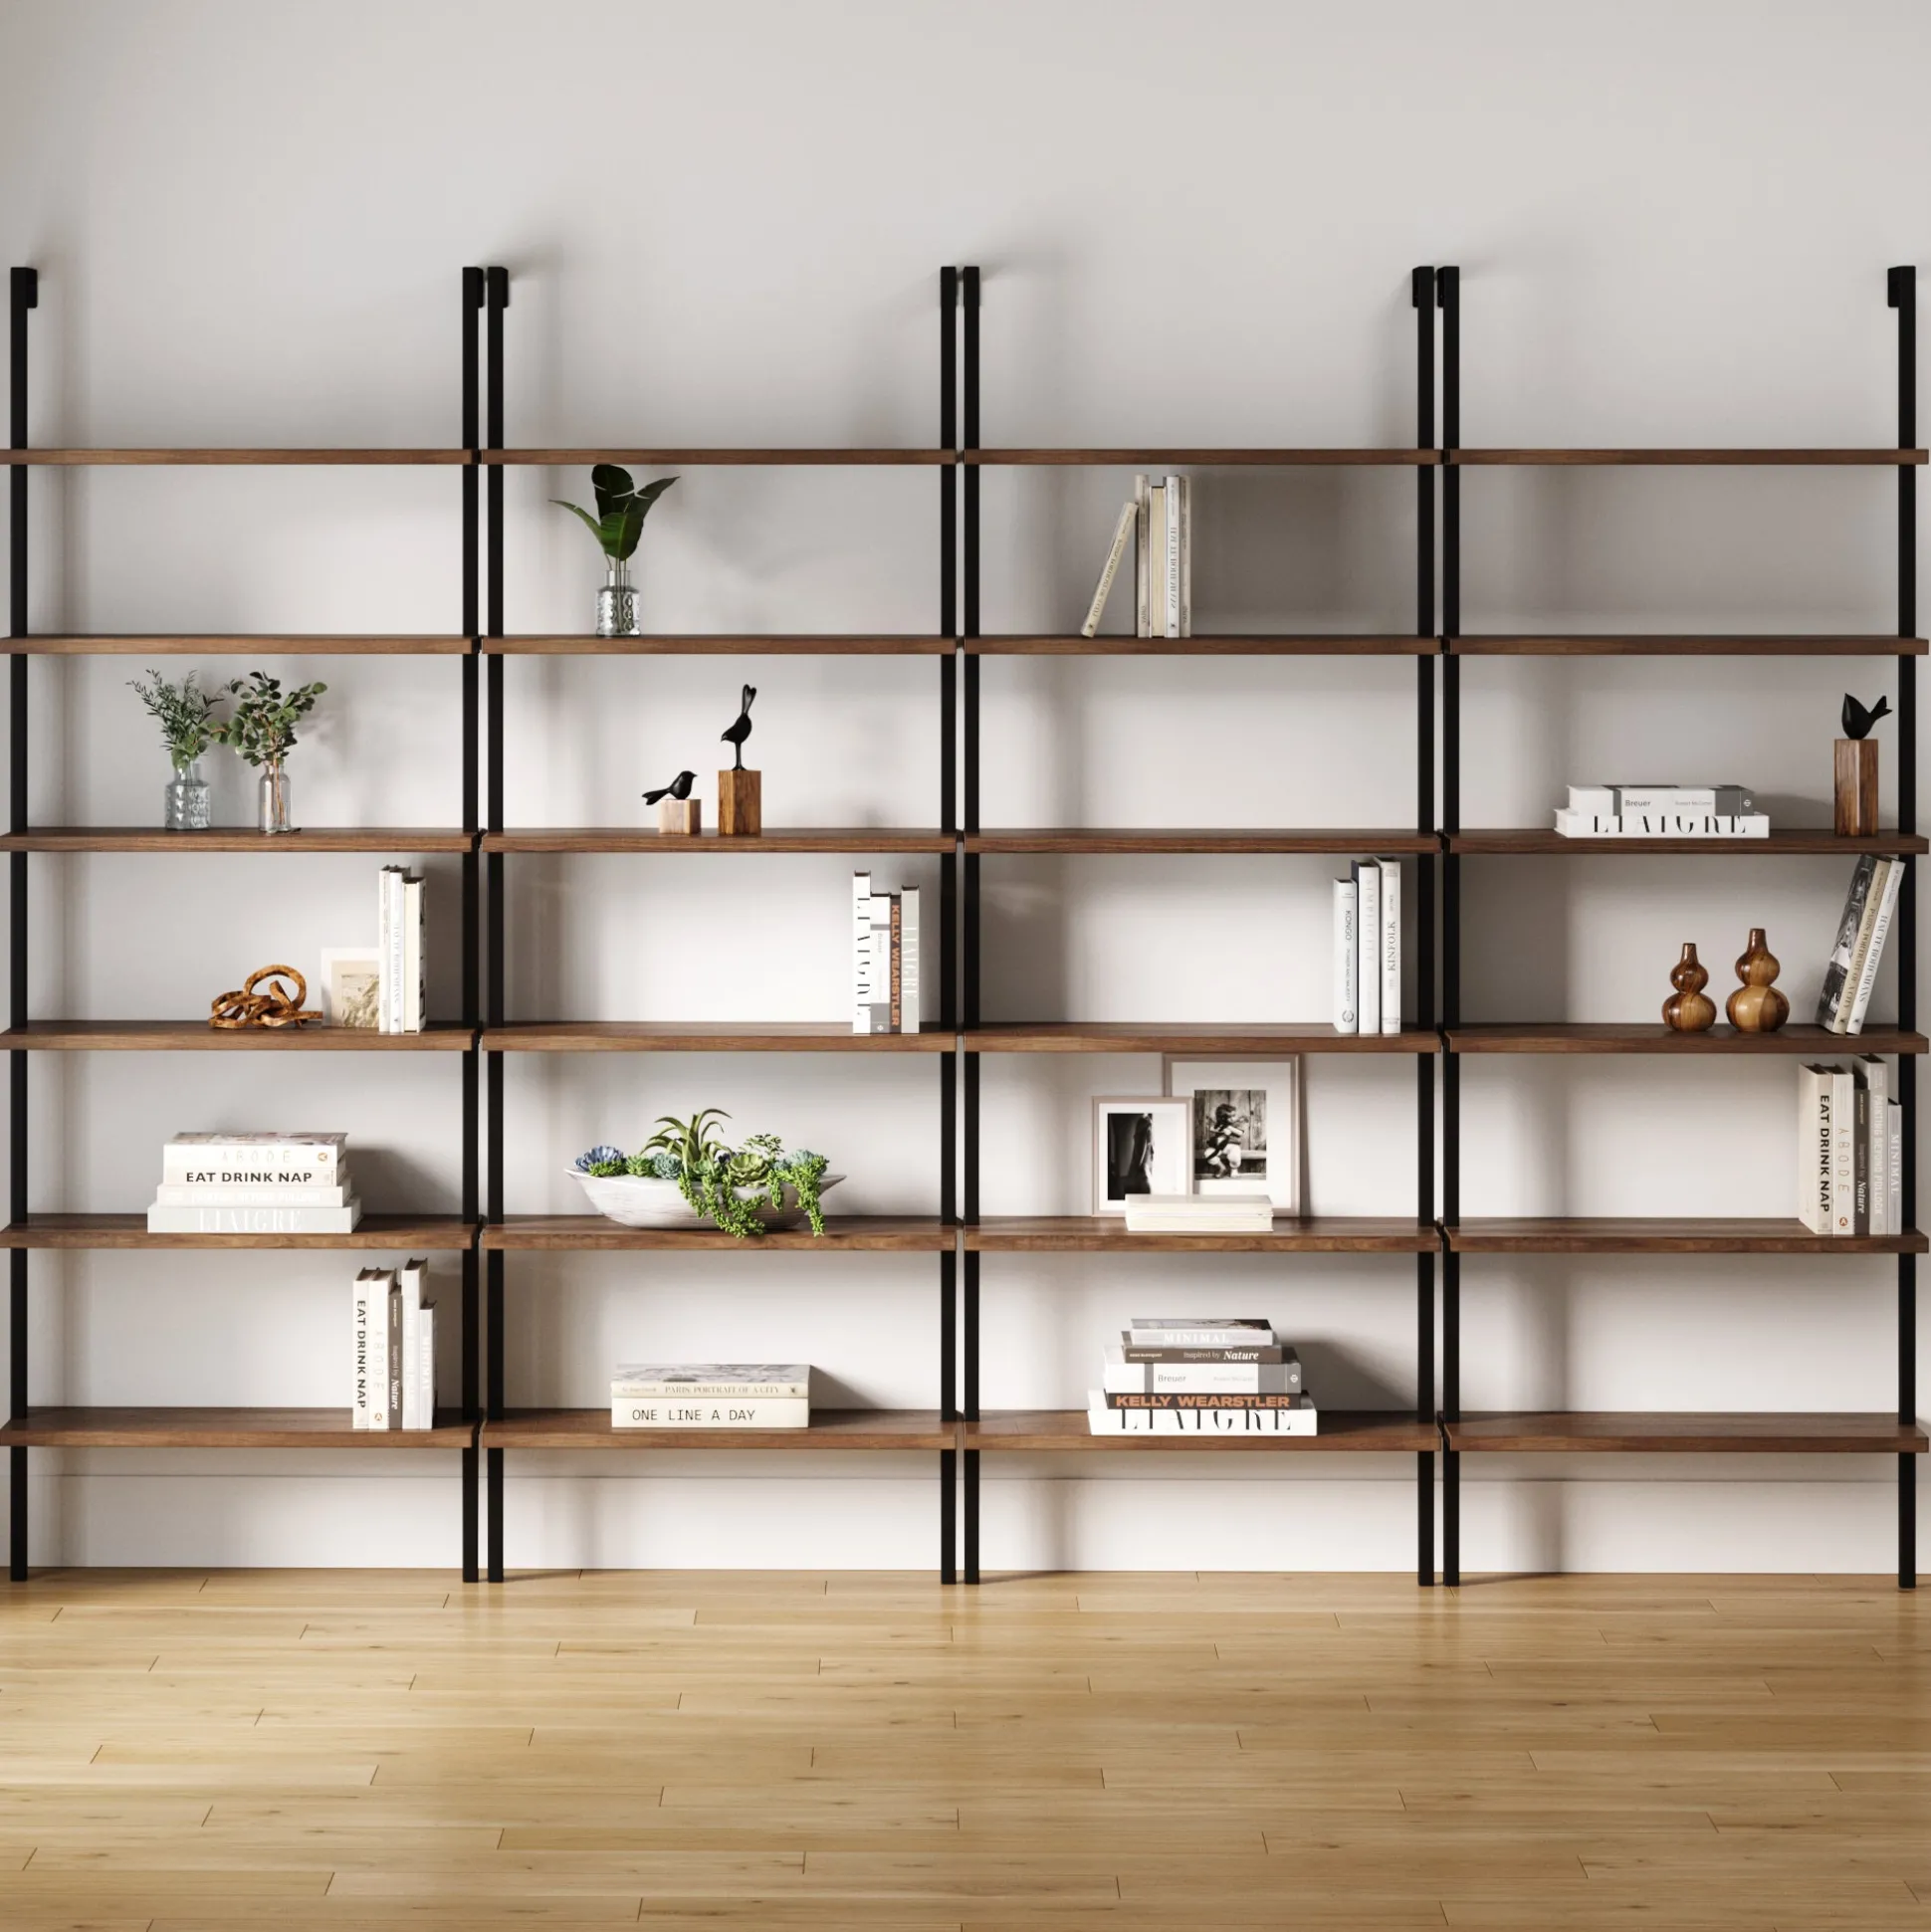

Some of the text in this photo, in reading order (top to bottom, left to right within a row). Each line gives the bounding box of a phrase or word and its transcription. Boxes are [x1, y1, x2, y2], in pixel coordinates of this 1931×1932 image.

[1873, 1095, 1883, 1135] PAINTING
[1821, 1095, 1829, 1212] EAT DRINK NAP
[1874, 1138, 1883, 1172] BEYOND
[1890, 1135, 1899, 1194] MINIMAL
[186, 1173, 312, 1182] EAT DRINK NAP
[1857, 1181, 1866, 1213] Nature
[1874, 1176, 1883, 1214] POLLOCK
[1164, 1334, 1229, 1344] MINIMAL
[1183, 1351, 1258, 1361] Inspired by Nature
[632, 1409, 755, 1420] ONE LINE A DAY
[1116, 1396, 1289, 1406] KELLY WEARSTLER
